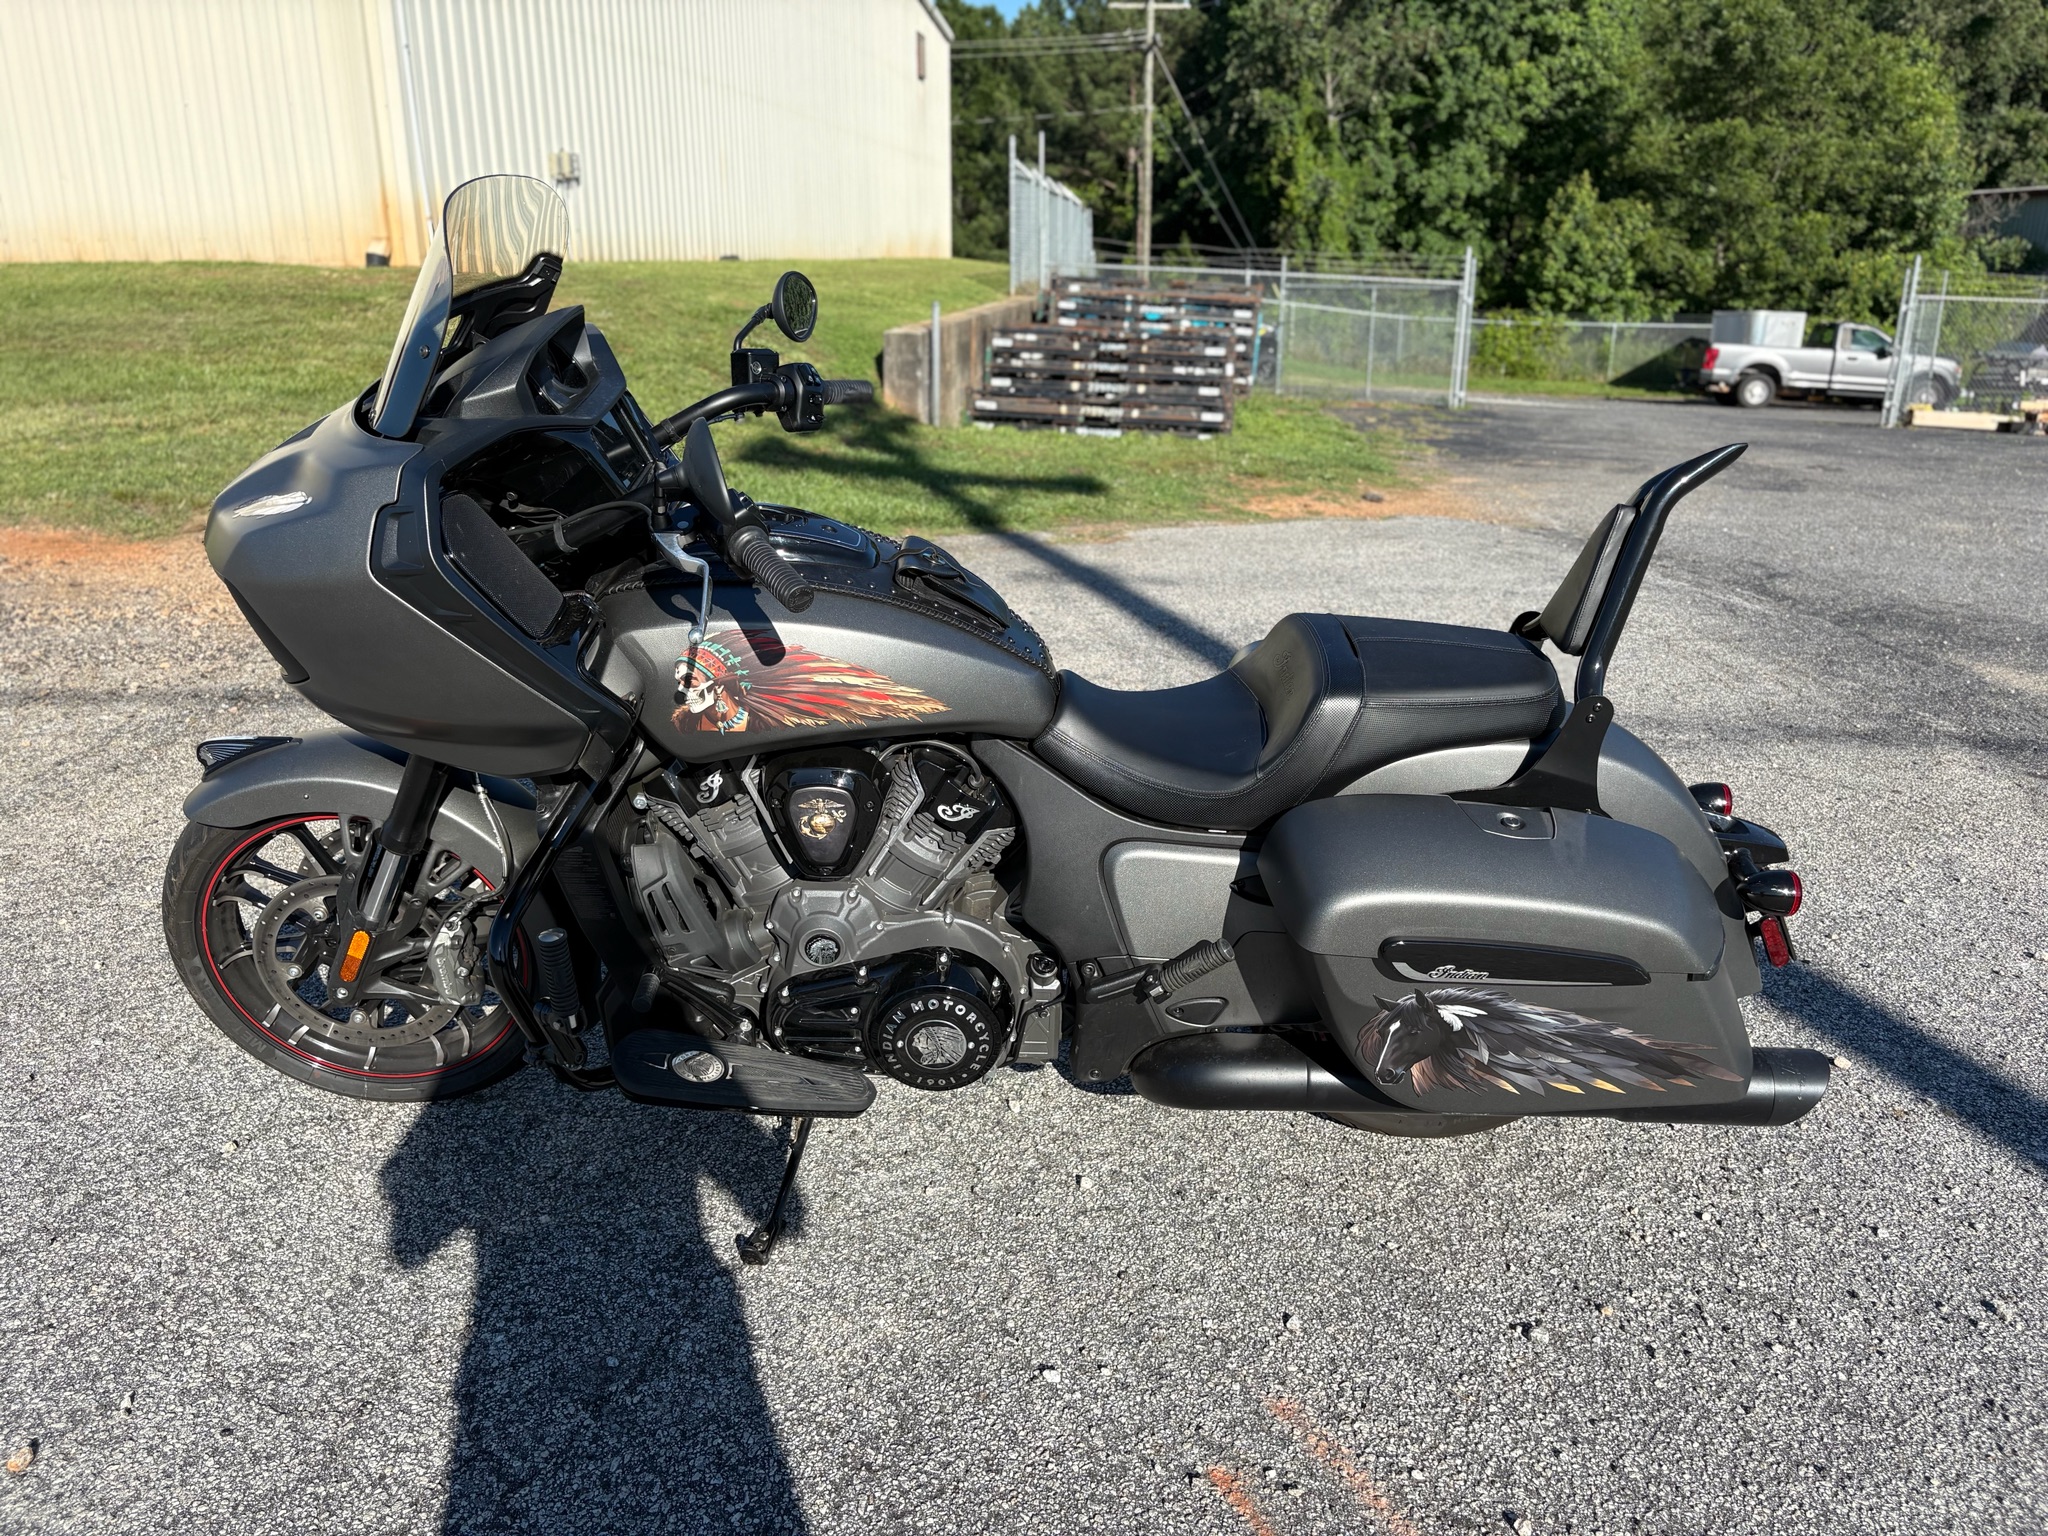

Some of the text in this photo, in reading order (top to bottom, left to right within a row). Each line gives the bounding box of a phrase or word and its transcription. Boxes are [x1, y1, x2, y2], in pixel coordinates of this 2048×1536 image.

[1427, 964, 1490, 980] Indian
[882, 998, 990, 1071] INDIAN MOTORCYCLE
